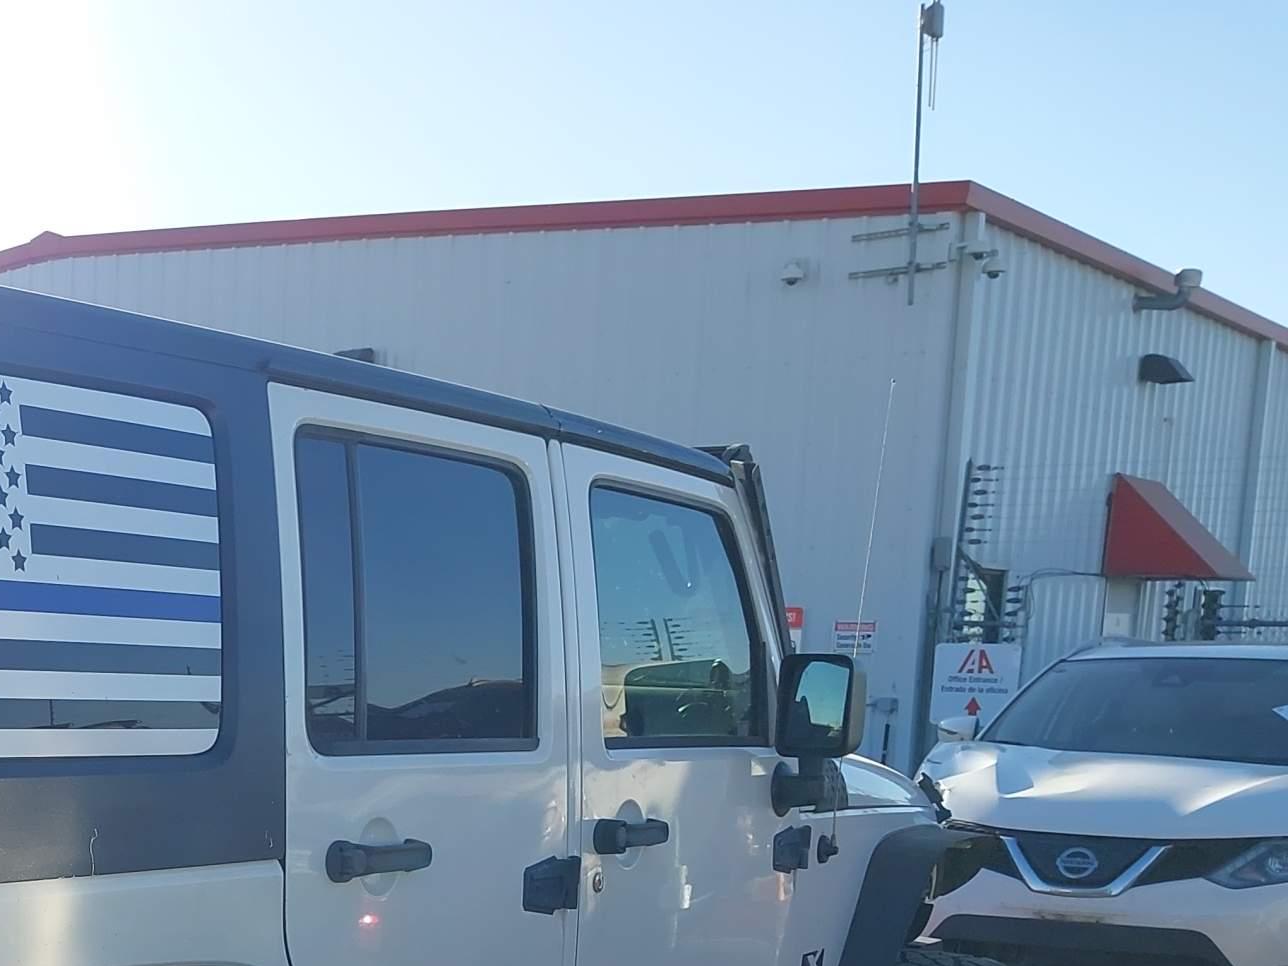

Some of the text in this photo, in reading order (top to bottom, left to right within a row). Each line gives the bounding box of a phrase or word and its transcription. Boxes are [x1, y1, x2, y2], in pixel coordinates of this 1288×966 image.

[947, 675, 968, 683] Office
[969, 675, 999, 684] Entrance
[967, 686, 977, 694] de
[978, 686, 985, 694] la
